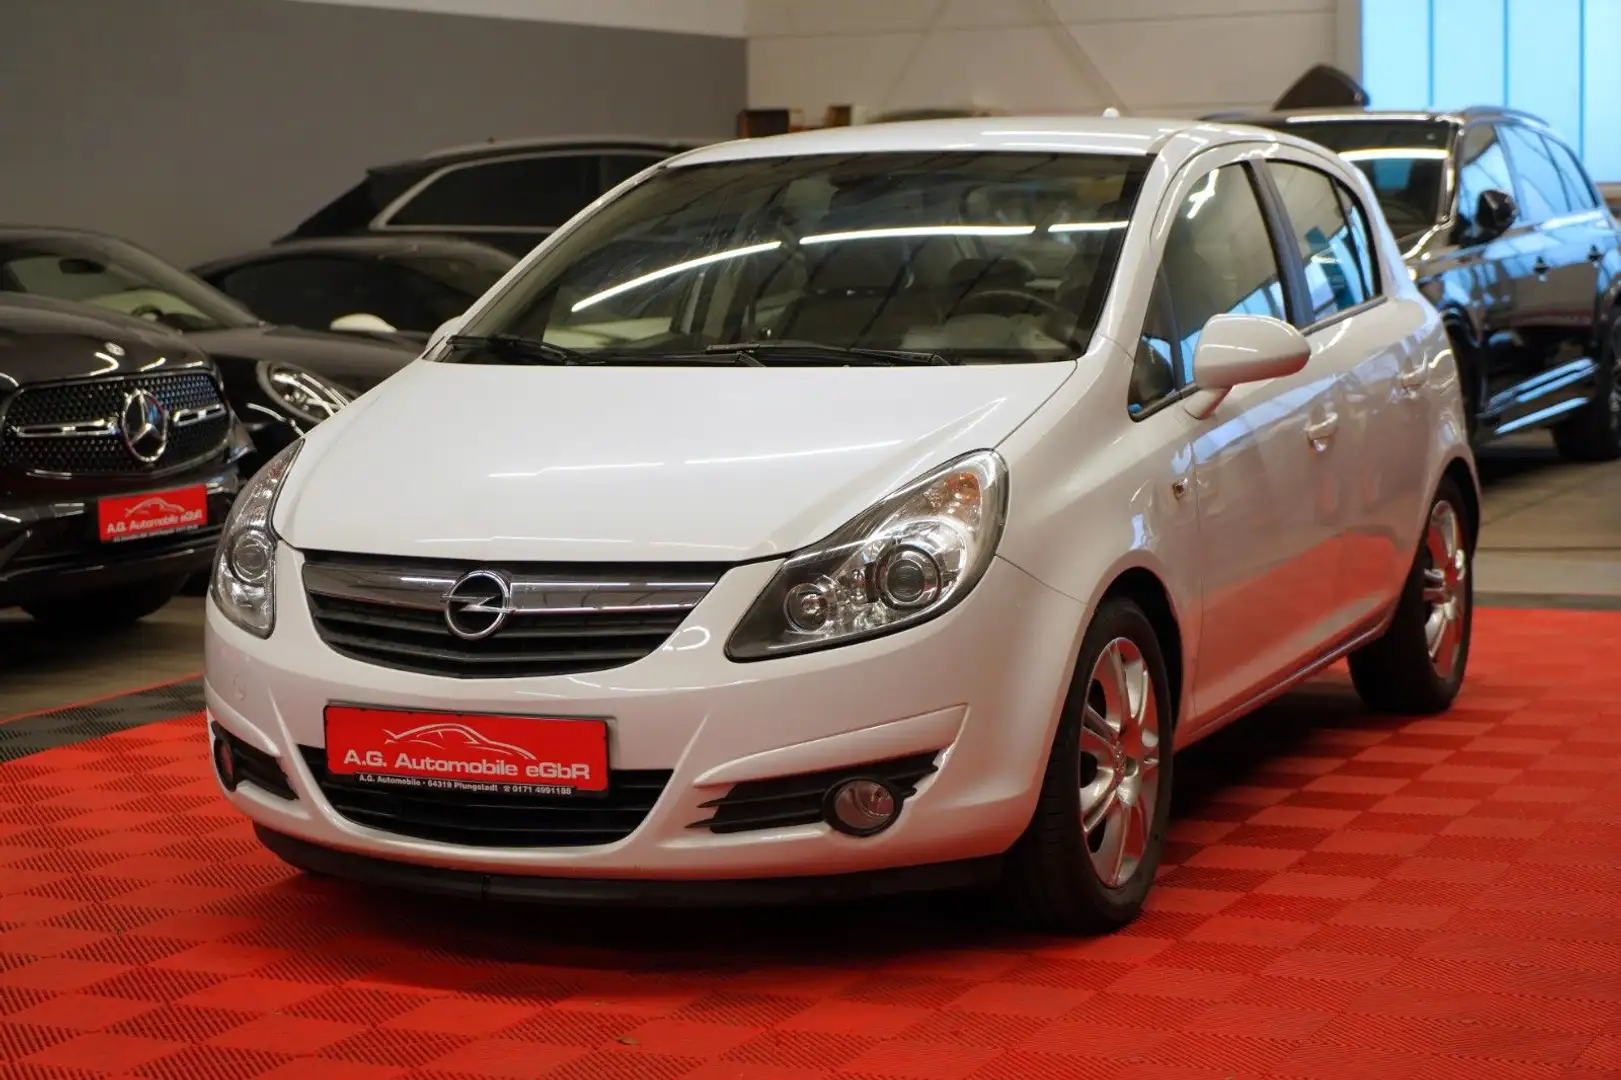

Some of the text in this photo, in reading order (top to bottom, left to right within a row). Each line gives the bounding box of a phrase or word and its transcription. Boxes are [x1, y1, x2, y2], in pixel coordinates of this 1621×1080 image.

[343, 748, 590, 779] A.G. Automobile eGbR
[359, 774, 375, 783] A.G.
[377, 775, 421, 786] Automobile
[427, 779, 453, 789] 64319
[511, 785, 532, 794] 0171
